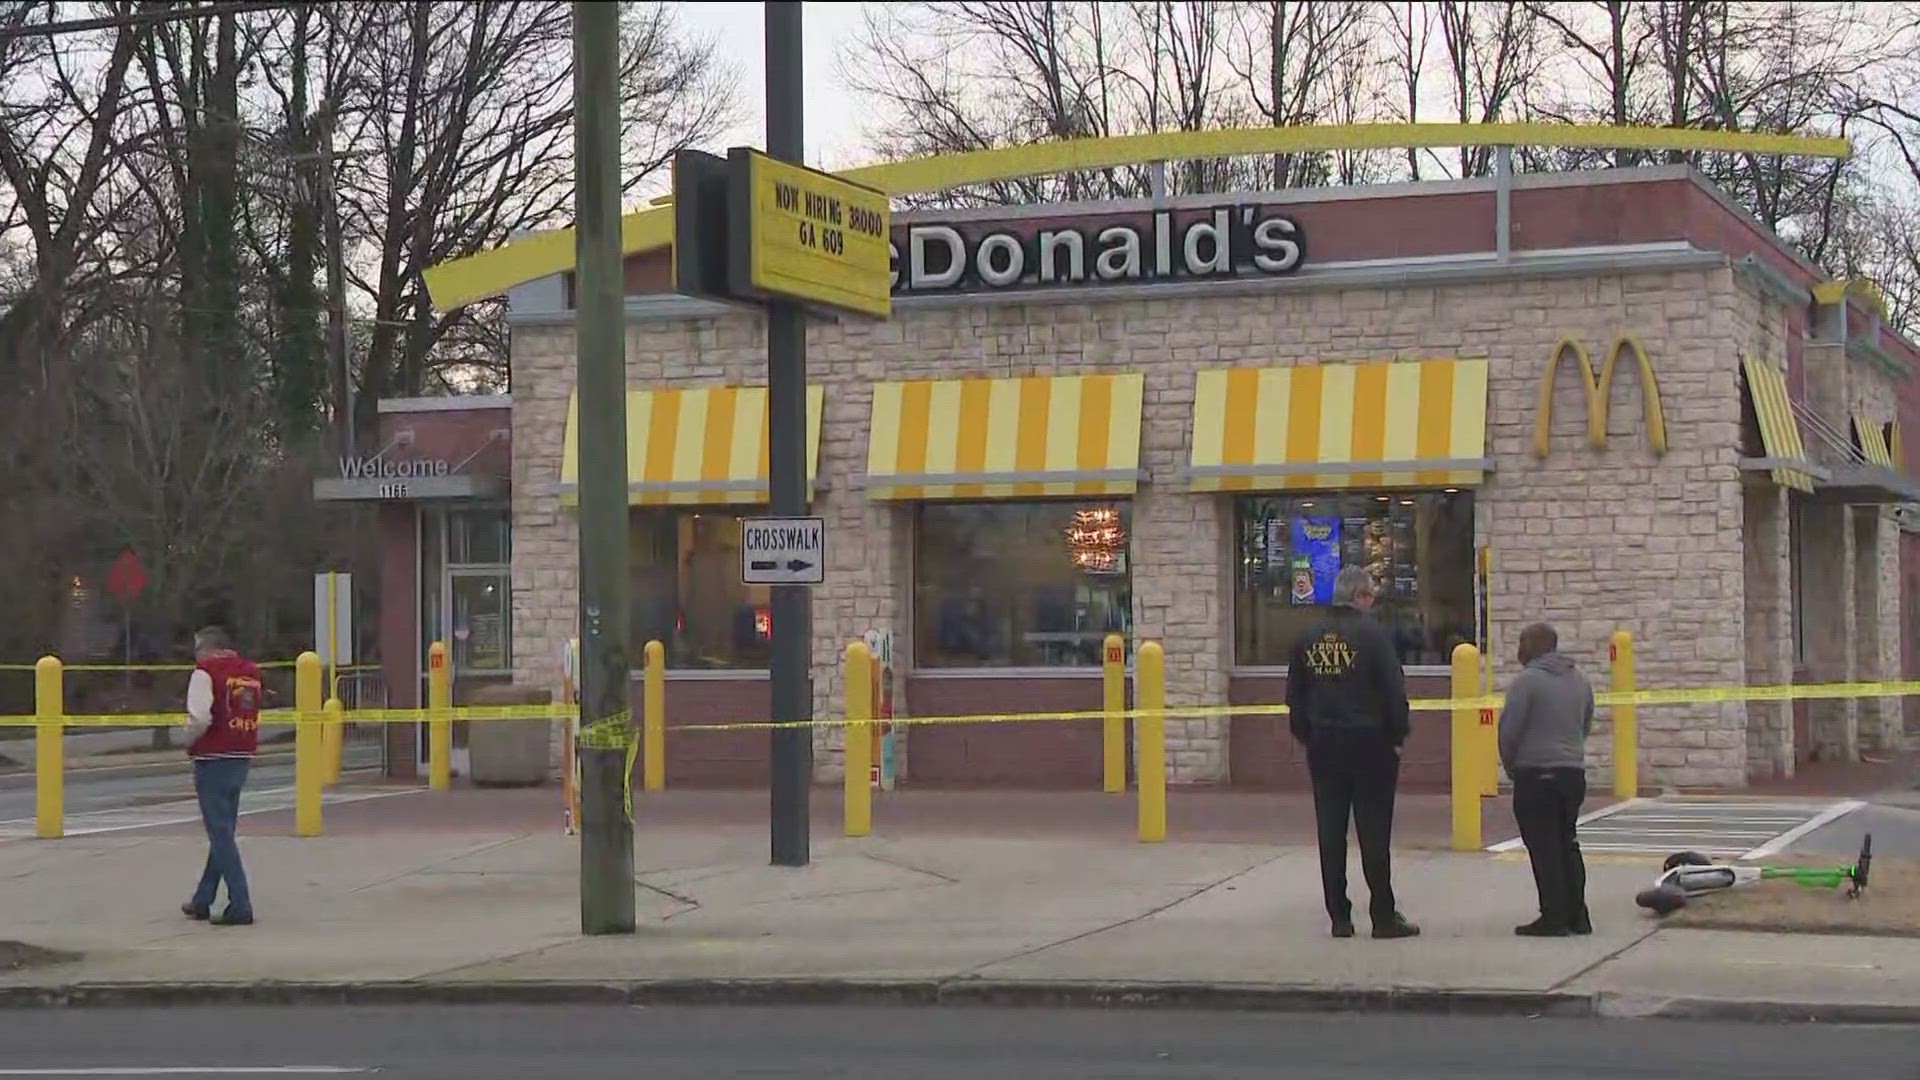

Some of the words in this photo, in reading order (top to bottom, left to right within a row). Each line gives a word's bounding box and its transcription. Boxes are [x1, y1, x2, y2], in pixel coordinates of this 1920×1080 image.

[776, 181, 799, 213] NOW
[805, 190, 842, 226] HIRING
[799, 221, 816, 249] GA
[823, 227, 843, 255] 609
[890, 207, 1300, 289] Donald's
[340, 456, 449, 478] Welcome
[381, 484, 407, 498] 1166
[746, 527, 819, 551] CROSSWALK
[1305, 650, 1358, 668] XXIV
